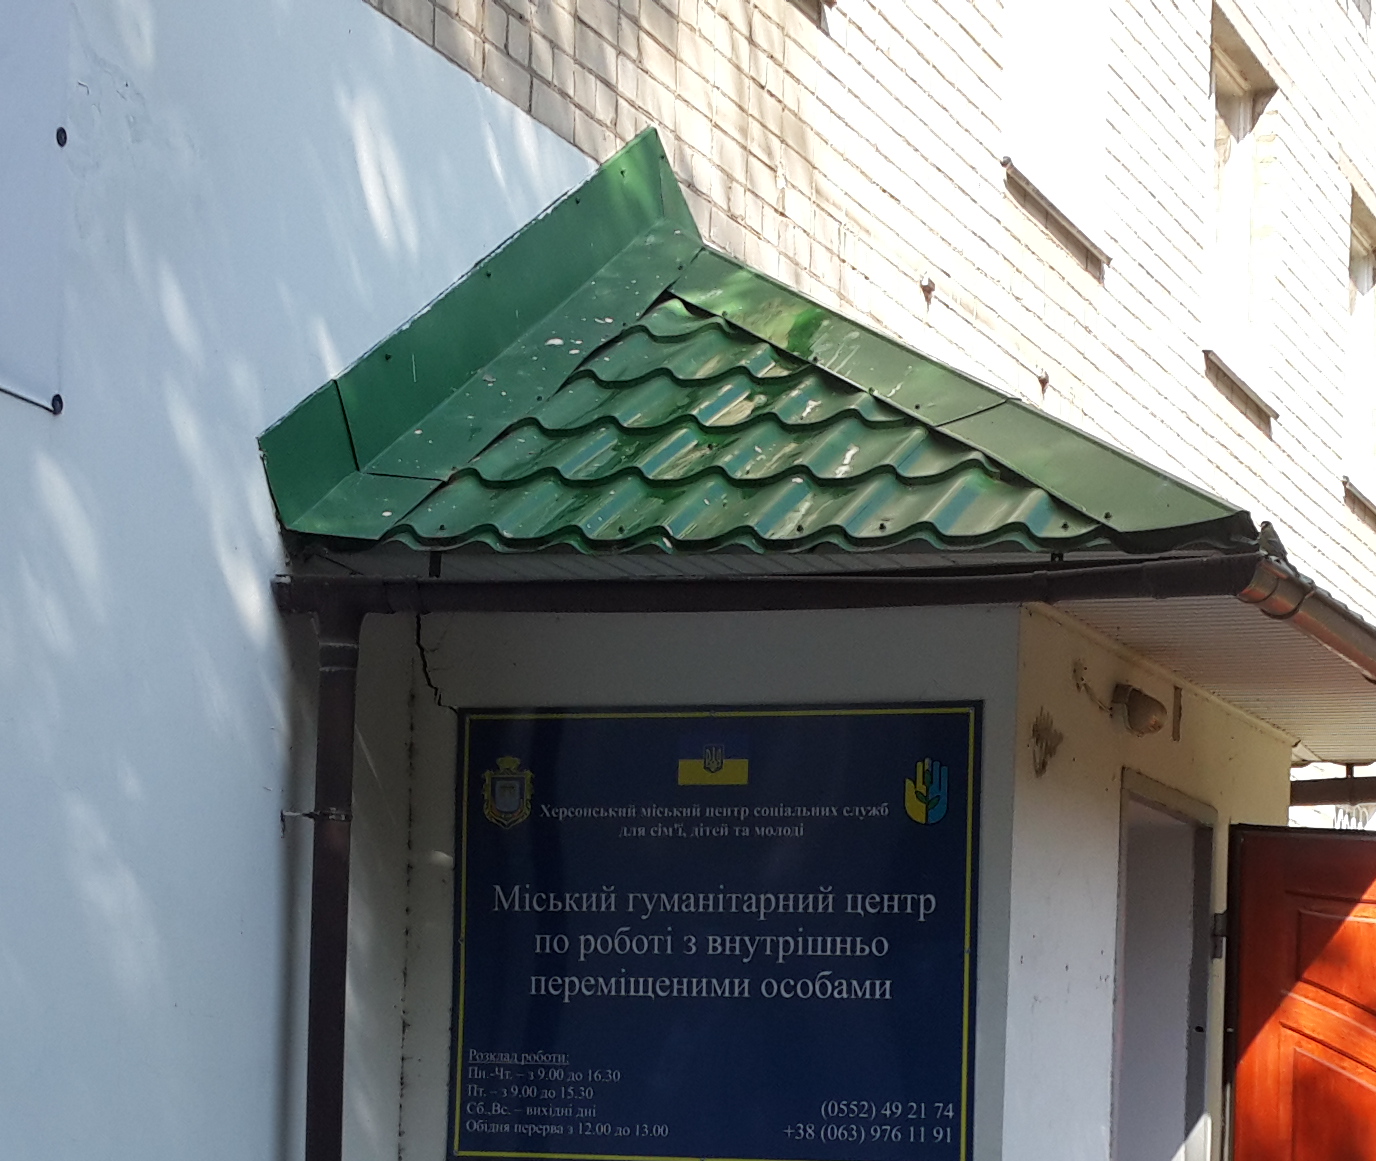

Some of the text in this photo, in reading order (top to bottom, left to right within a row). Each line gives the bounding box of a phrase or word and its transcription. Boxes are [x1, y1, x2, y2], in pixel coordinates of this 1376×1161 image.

[538, 802, 890, 822] Херсонський міський центр соціальних служб
[618, 825, 646, 839] для
[690, 824, 728, 839] дітей
[733, 825, 751, 837] та
[755, 824, 805, 839] молоді
[492, 884, 937, 922] Міський гуманітарний центр
[534, 926, 890, 963] по роботі з внутрішньо
[529, 970, 893, 1003] переміщеними особами
[468, 1049, 570, 1065] Розклад роботи:
[538, 1068, 564, 1081] 9.00
[567, 1072, 583, 1082] до
[588, 1069, 621, 1082] 16.30
[467, 1084, 487, 1098] Пт.
[510, 1085, 537, 1098] 9.00
[540, 1089, 556, 1099] до
[561, 1086, 594, 1100] 15.30
[526, 1104, 573, 1117] вихідні
[576, 1104, 597, 1118] дні
[821, 1100, 955, 1120] (0552) 49 21 74
[466, 1119, 669, 1137] Обідня перерва з 12.00 до 13.00
[783, 1123, 952, 1144] +38 (063) 976 11 91
